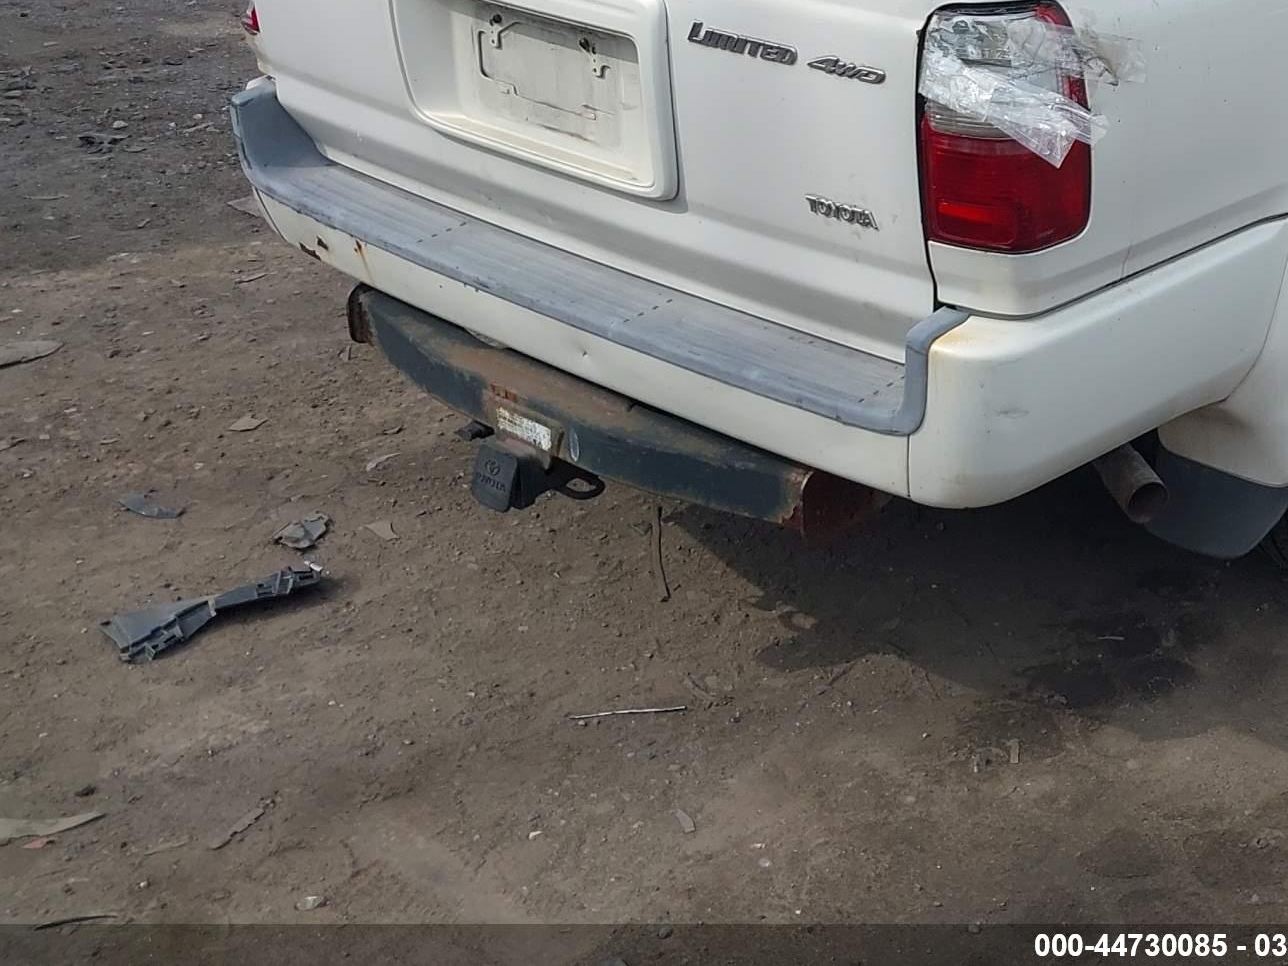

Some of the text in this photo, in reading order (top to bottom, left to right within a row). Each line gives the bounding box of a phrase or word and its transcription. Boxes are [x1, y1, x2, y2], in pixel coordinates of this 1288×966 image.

[687, 19, 887, 85] LIMITED 4WD
[804, 194, 880, 231] TOYOTA
